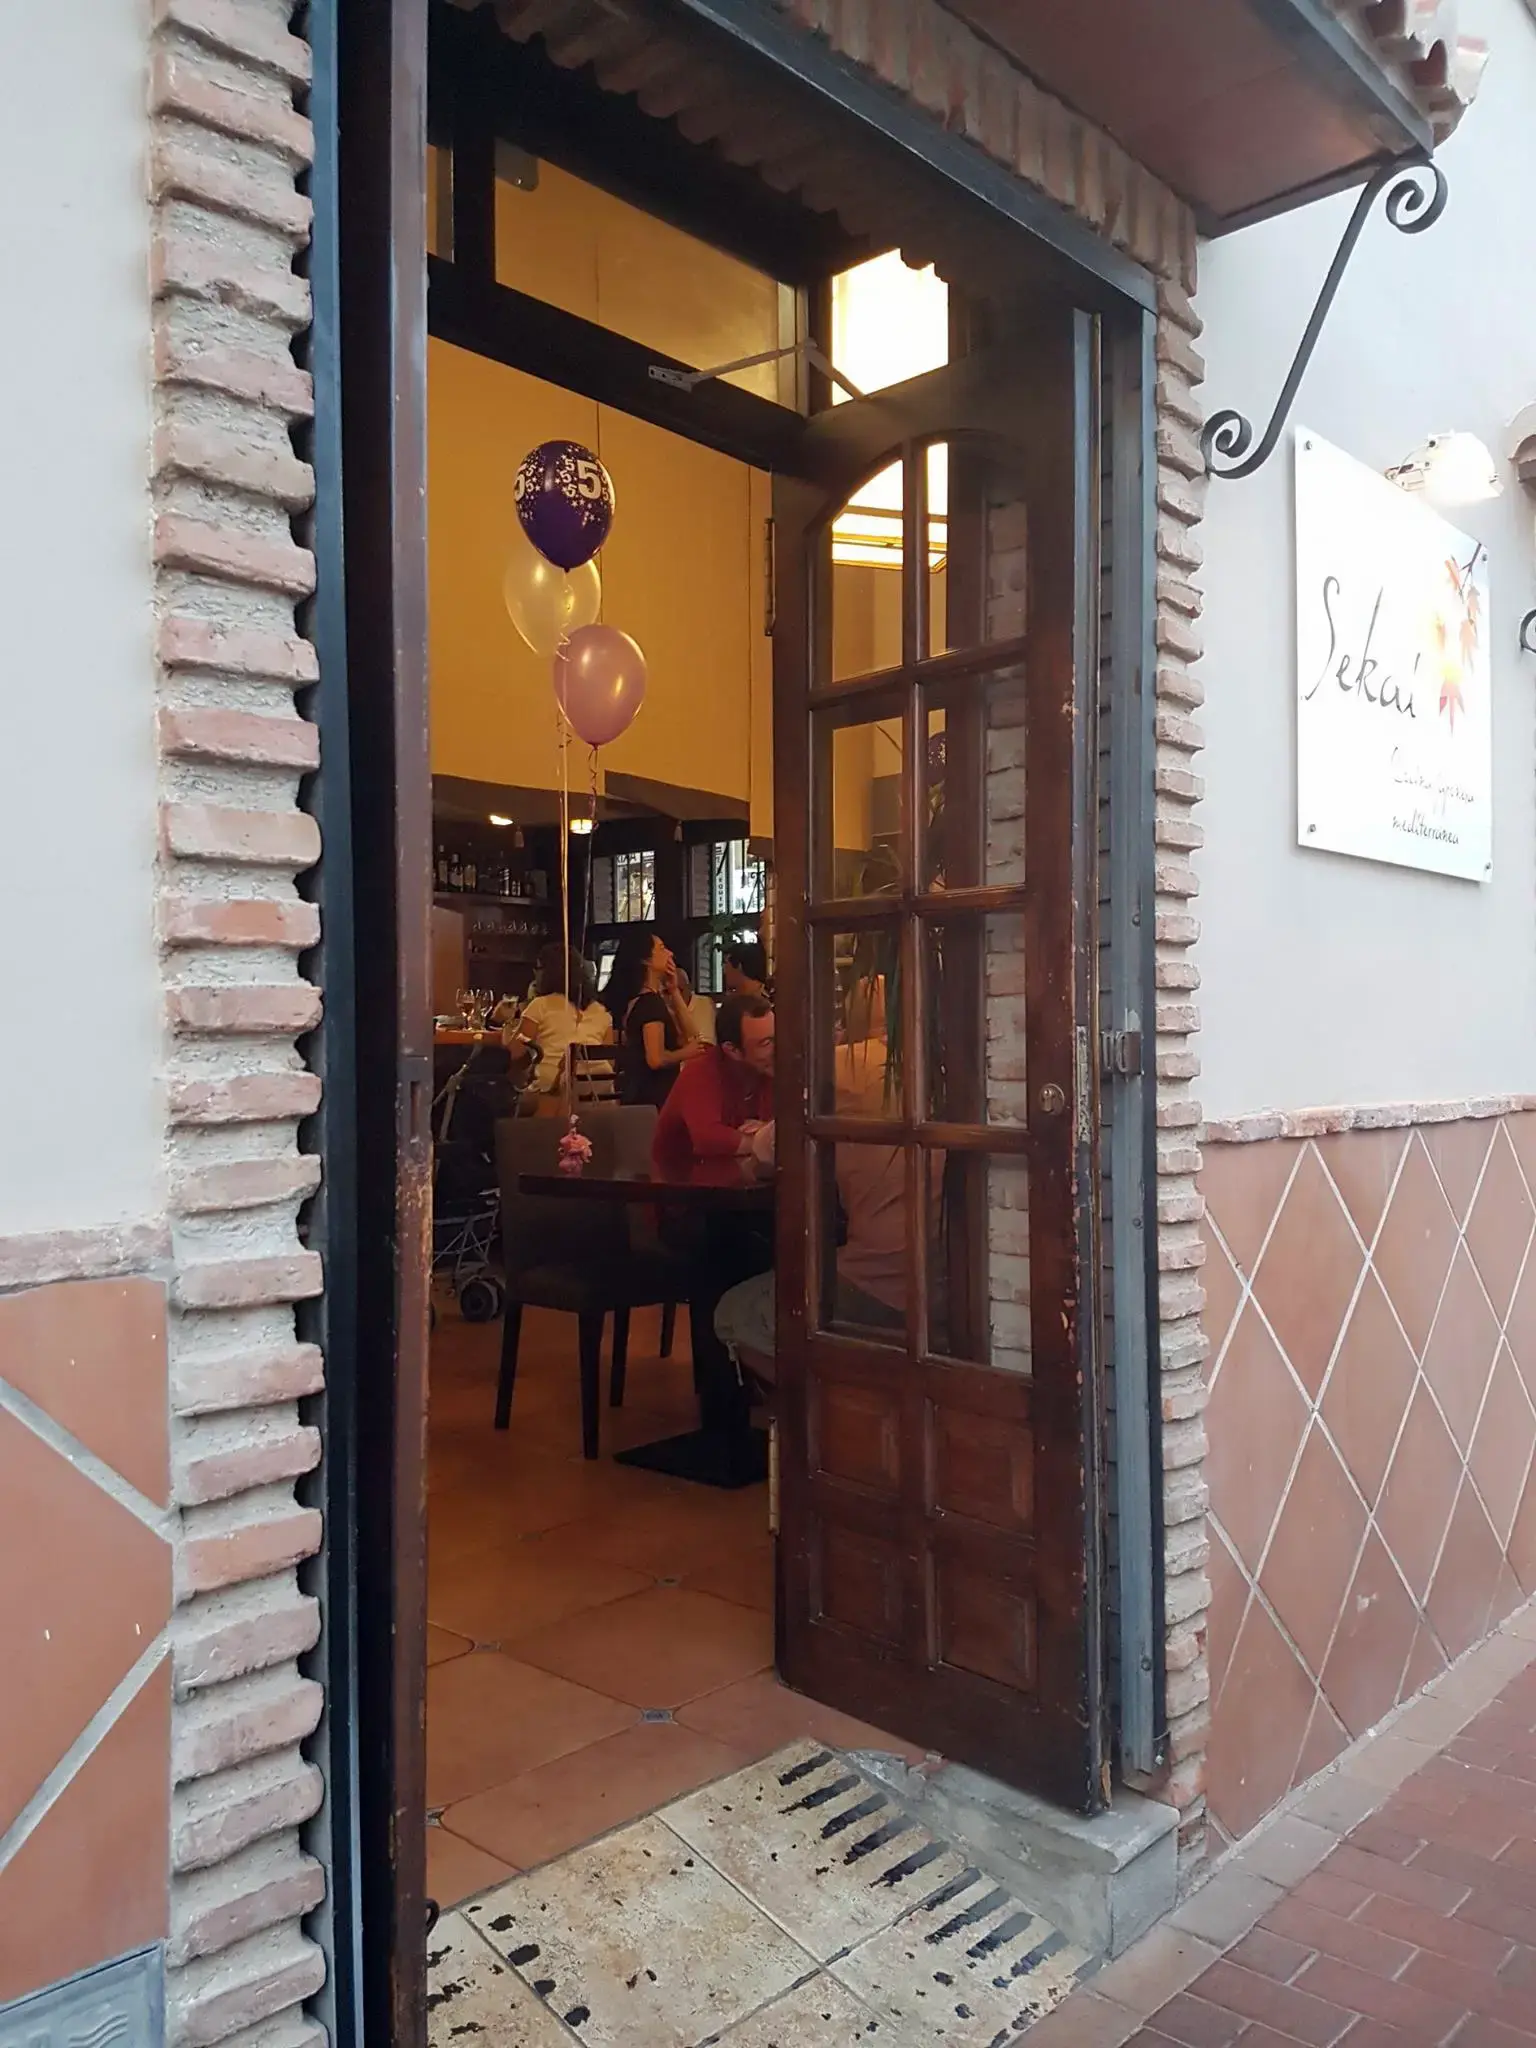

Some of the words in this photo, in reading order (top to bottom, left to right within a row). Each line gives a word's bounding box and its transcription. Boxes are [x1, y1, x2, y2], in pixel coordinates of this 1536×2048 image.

[526, 464, 536, 477] 5
[564, 459, 575, 471] 5
[560, 470, 572, 483] 5
[577, 459, 601, 500] 5
[525, 480, 534, 493] 5
[566, 484, 577, 498] 5
